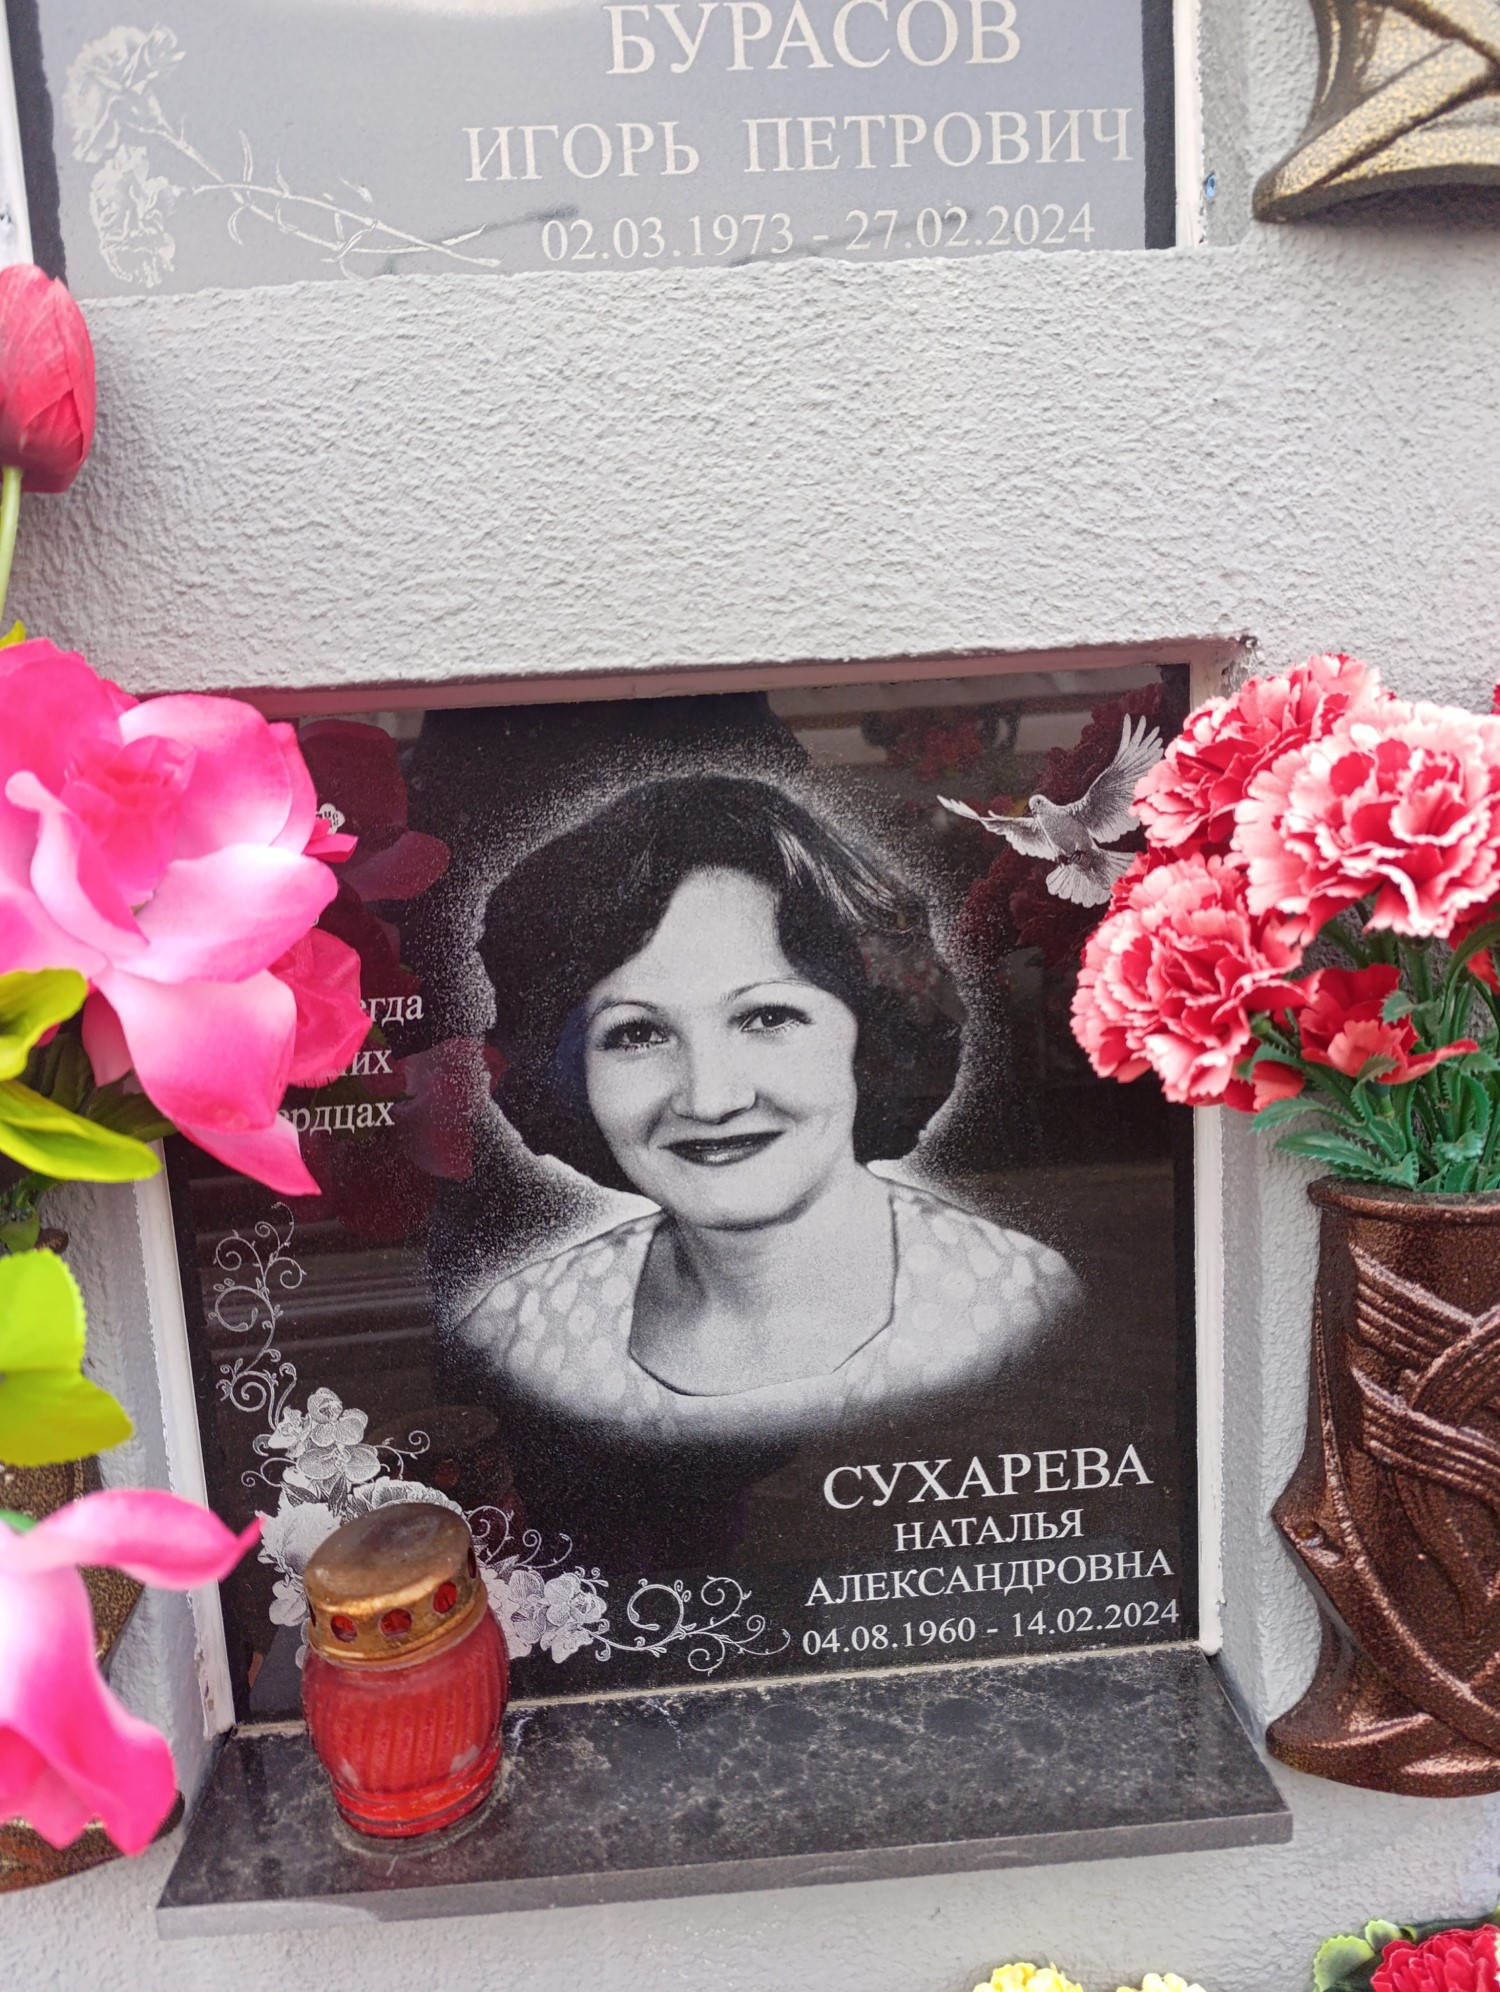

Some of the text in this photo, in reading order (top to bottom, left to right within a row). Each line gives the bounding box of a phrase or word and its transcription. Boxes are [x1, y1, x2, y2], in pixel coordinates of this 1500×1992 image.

[603, 0, 1021, 74] БУРАСОВ
[462, 107, 1133, 182] ИГОРЬ ПЕТРОВИЧ
[541, 212, 794, 261] 02.03.1973
[845, 202, 1095, 250] 27.02.2024
[823, 1444, 1154, 1510] СУХАРЕВА
[894, 1508, 1085, 1552] НАТАЛЬЯ
[804, 1548, 1175, 1607] АЛЕКСАНДРОВНА
[802, 1616, 977, 1656] 04.08.1960
[1012, 1598, 1179, 1638] 14.02.2024
